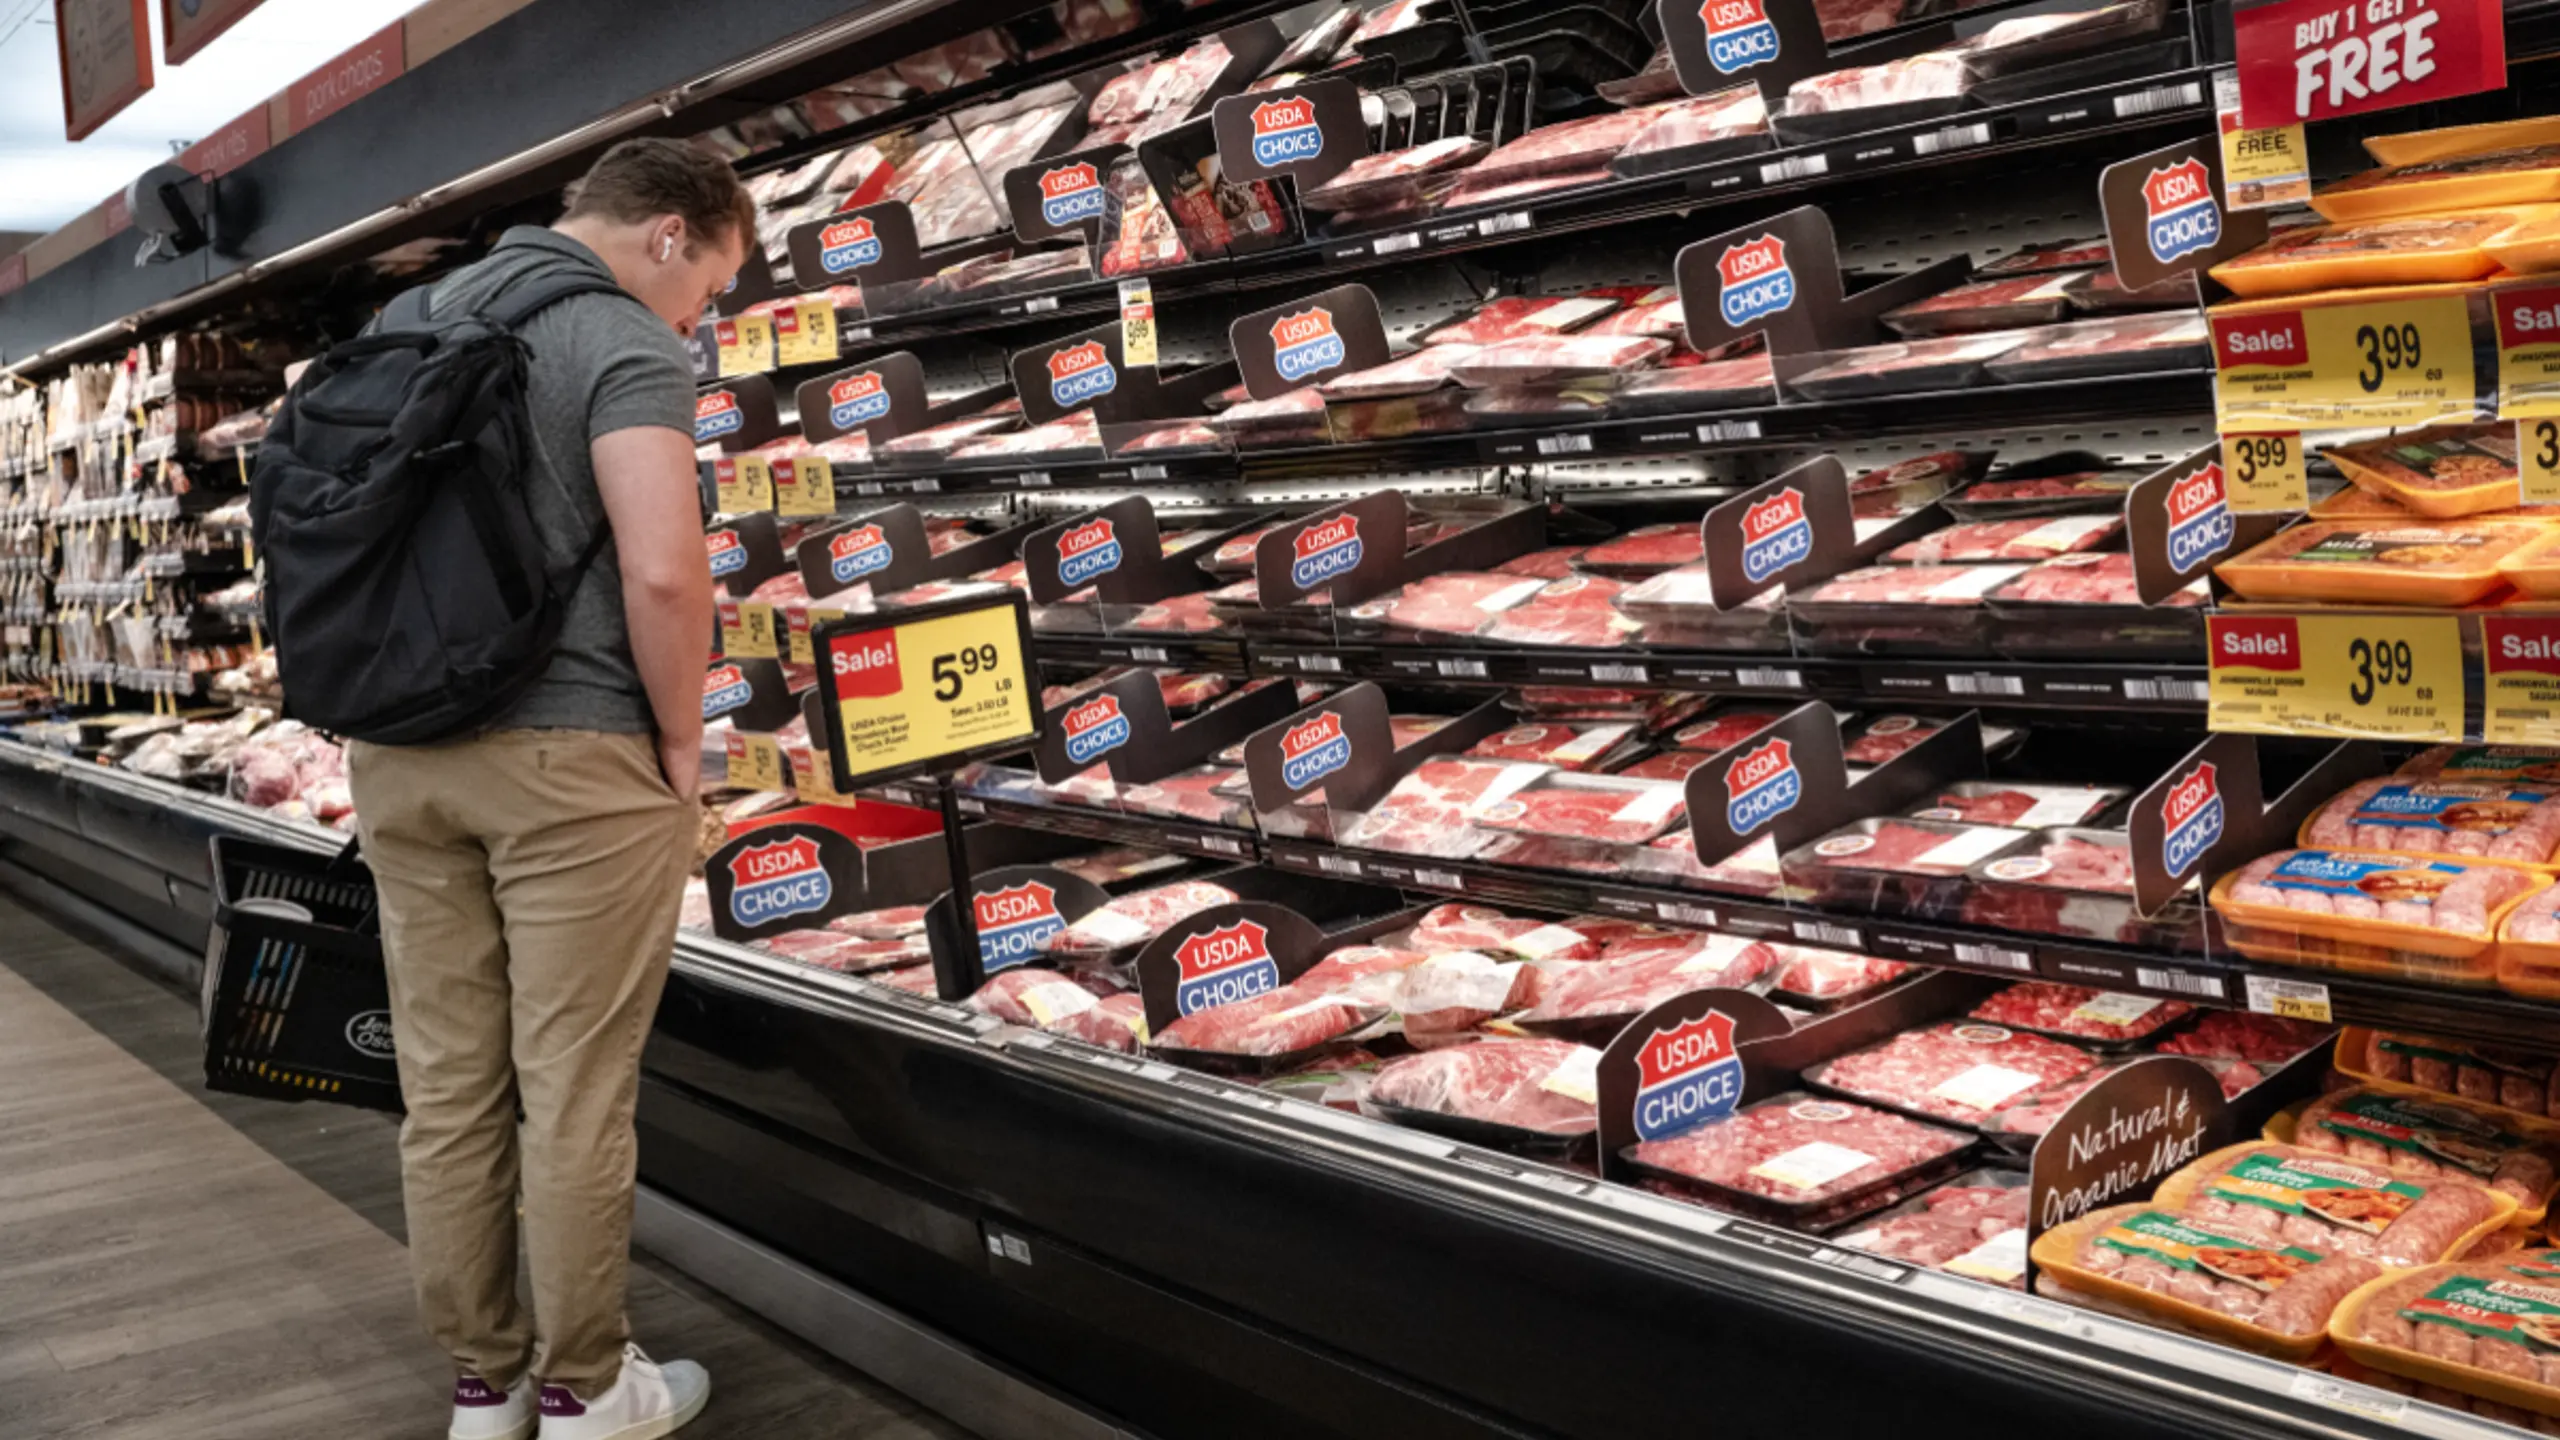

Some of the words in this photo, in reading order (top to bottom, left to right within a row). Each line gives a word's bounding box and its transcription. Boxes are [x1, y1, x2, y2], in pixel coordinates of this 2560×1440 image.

[1712, 2, 1757, 24] USDA
[2295, 10, 2339, 50] BUY
[2346, 4, 2356, 32] 1
[2366, 0, 2403, 24] GET
[1715, 31, 1775, 61] CHOICE
[338, 50, 384, 96] chops
[2295, 9, 2439, 117] FREE
[1264, 108, 1305, 127] USDA
[1261, 133, 1317, 155] CHOICE
[2237, 134, 2287, 155] FREE
[1050, 172, 1089, 191] USDA
[2155, 173, 2199, 204] USDA
[1050, 194, 1103, 218] CHOICE
[830, 226, 865, 243] USDA
[2154, 213, 2217, 249] CHOICE
[828, 243, 878, 264] CHOICE
[1730, 249, 1774, 277] USDA
[1727, 279, 1789, 314] CHOICE
[1283, 317, 1324, 341] USDA
[2228, 329, 2293, 353] Sale!
[1060, 350, 1096, 370] USDA
[1282, 342, 1339, 371] CHOICE
[1058, 371, 1111, 399] CHOICE
[2425, 368, 2443, 381] ea
[839, 380, 874, 398] USDA
[837, 398, 885, 420] CHOICE
[2177, 481, 2217, 514] USDA
[1753, 503, 1794, 532] USDA
[839, 533, 874, 551] USDA
[1069, 529, 1105, 550] USDA
[1307, 525, 1346, 549] USDA
[2174, 516, 2231, 561] CHOICE
[837, 548, 888, 573] CHOICE
[1067, 551, 1117, 578] CHOICE
[1298, 549, 1357, 579] CHOICE
[1750, 530, 1806, 573] CHOICE
[2223, 631, 2287, 655] Sale!
[831, 642, 893, 675] Sale!
[996, 677, 1012, 692] LB
[2416, 687, 2433, 700] ea
[1073, 704, 1111, 728] USDA
[1073, 725, 1125, 754] CHOICE
[1294, 721, 1331, 748] USDA
[1290, 743, 1344, 780] CHOICE
[1737, 752, 1781, 784] USDA
[1736, 780, 1796, 822] CHOICE
[2173, 780, 2209, 819] USDA
[2170, 811, 2221, 863] CHOICE
[749, 848, 806, 878] USDA
[740, 878, 825, 916] CHOICE
[982, 893, 1041, 923] USDA
[1194, 933, 1252, 968] USDA
[1187, 968, 1271, 1012] CHOICE
[1658, 1028, 1720, 1072] USDA
[1644, 1070, 1736, 1128] CHOICE
[2068, 1086, 2172, 1171] Natural
[2174, 1088, 2190, 1129] &
[2357, 1115, 2394, 1129] HOT
[2042, 1161, 2139, 1229] Organic
[2142, 1115, 2207, 1183] Meat
[2445, 1302, 2492, 1317] HOT
[457, 1388, 488, 1398] VEJA
[541, 1396, 562, 1407] EJA
